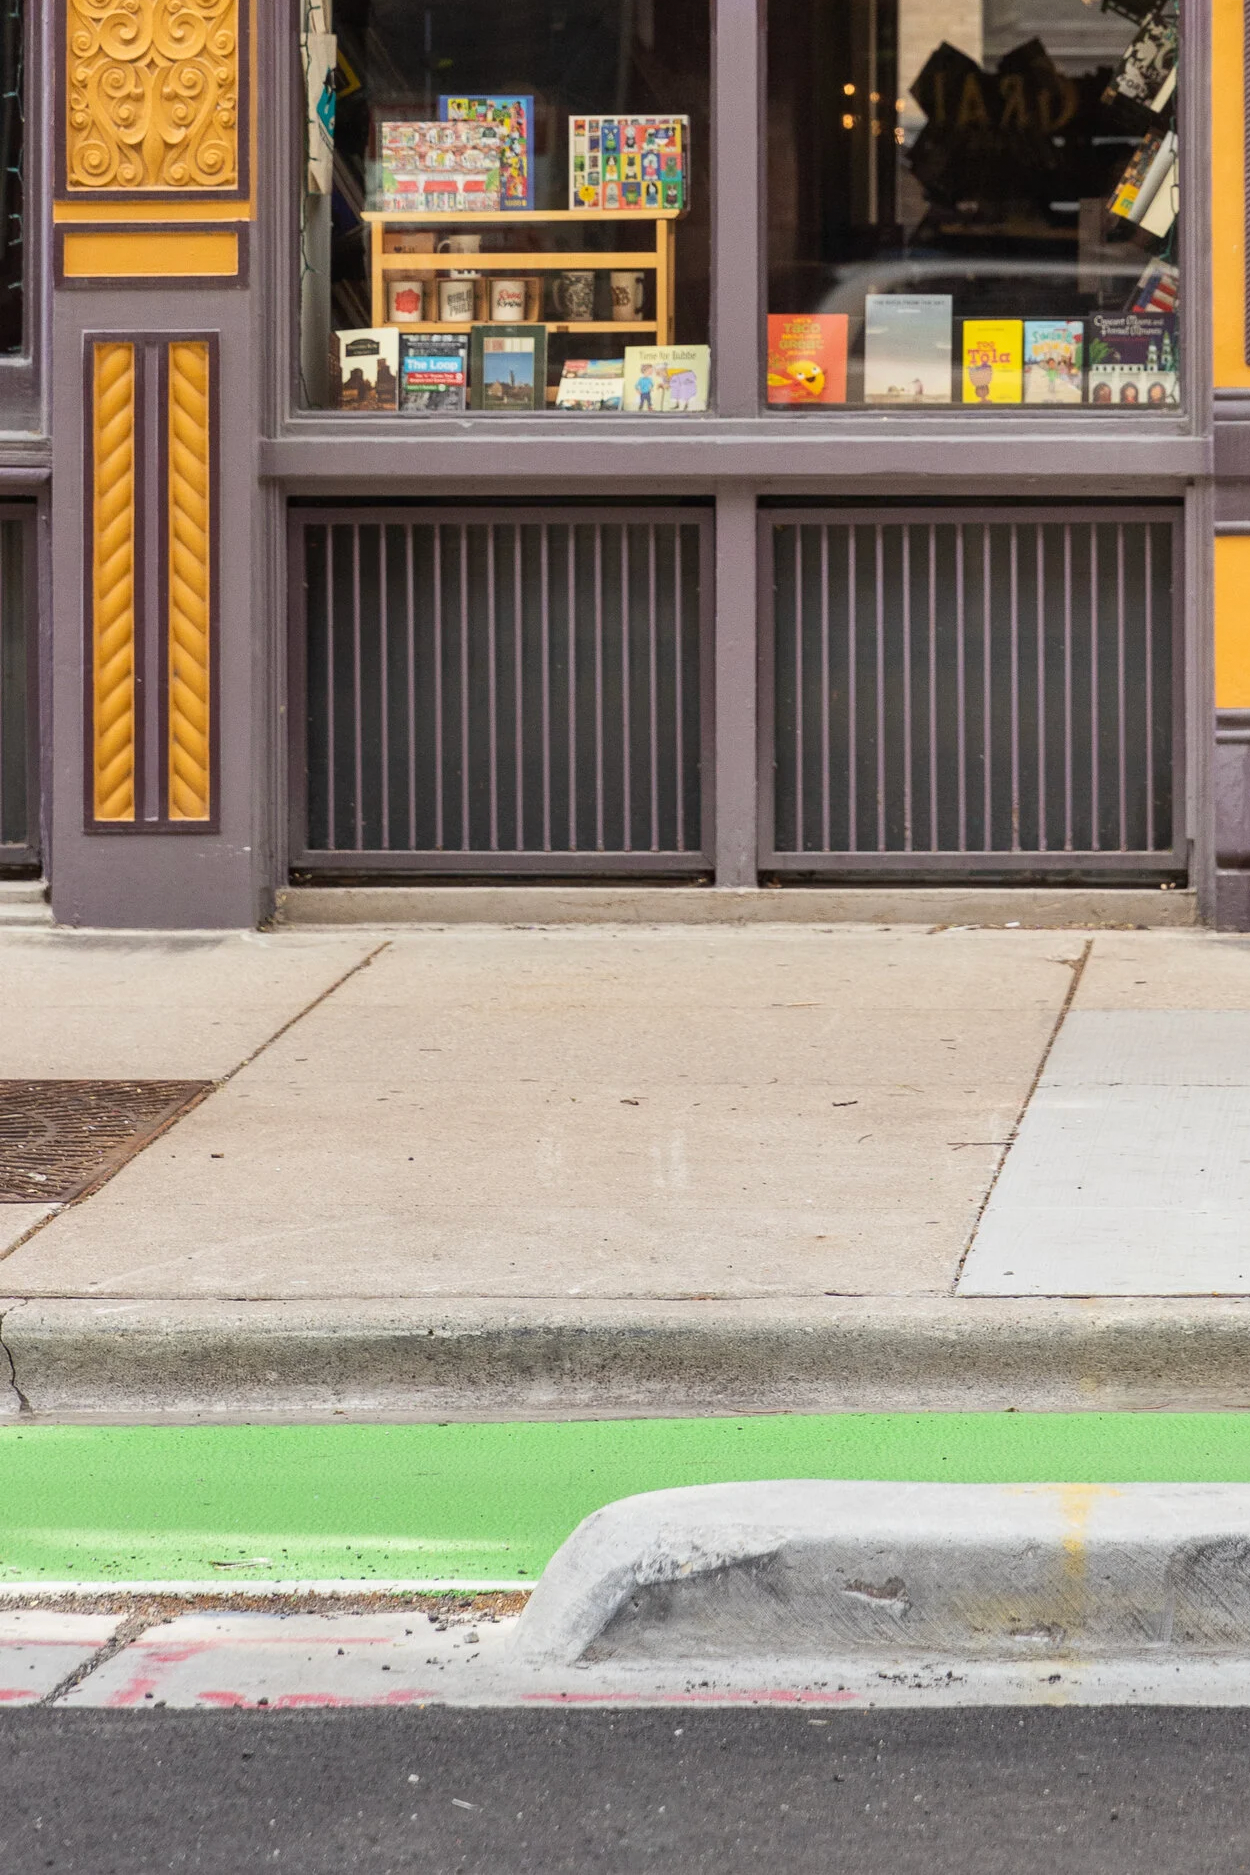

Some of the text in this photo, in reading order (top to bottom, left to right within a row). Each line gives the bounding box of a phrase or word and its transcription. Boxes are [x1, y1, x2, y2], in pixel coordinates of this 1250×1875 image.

[968, 349, 1011, 364] Tola
[407, 359, 459, 372] The Loop
